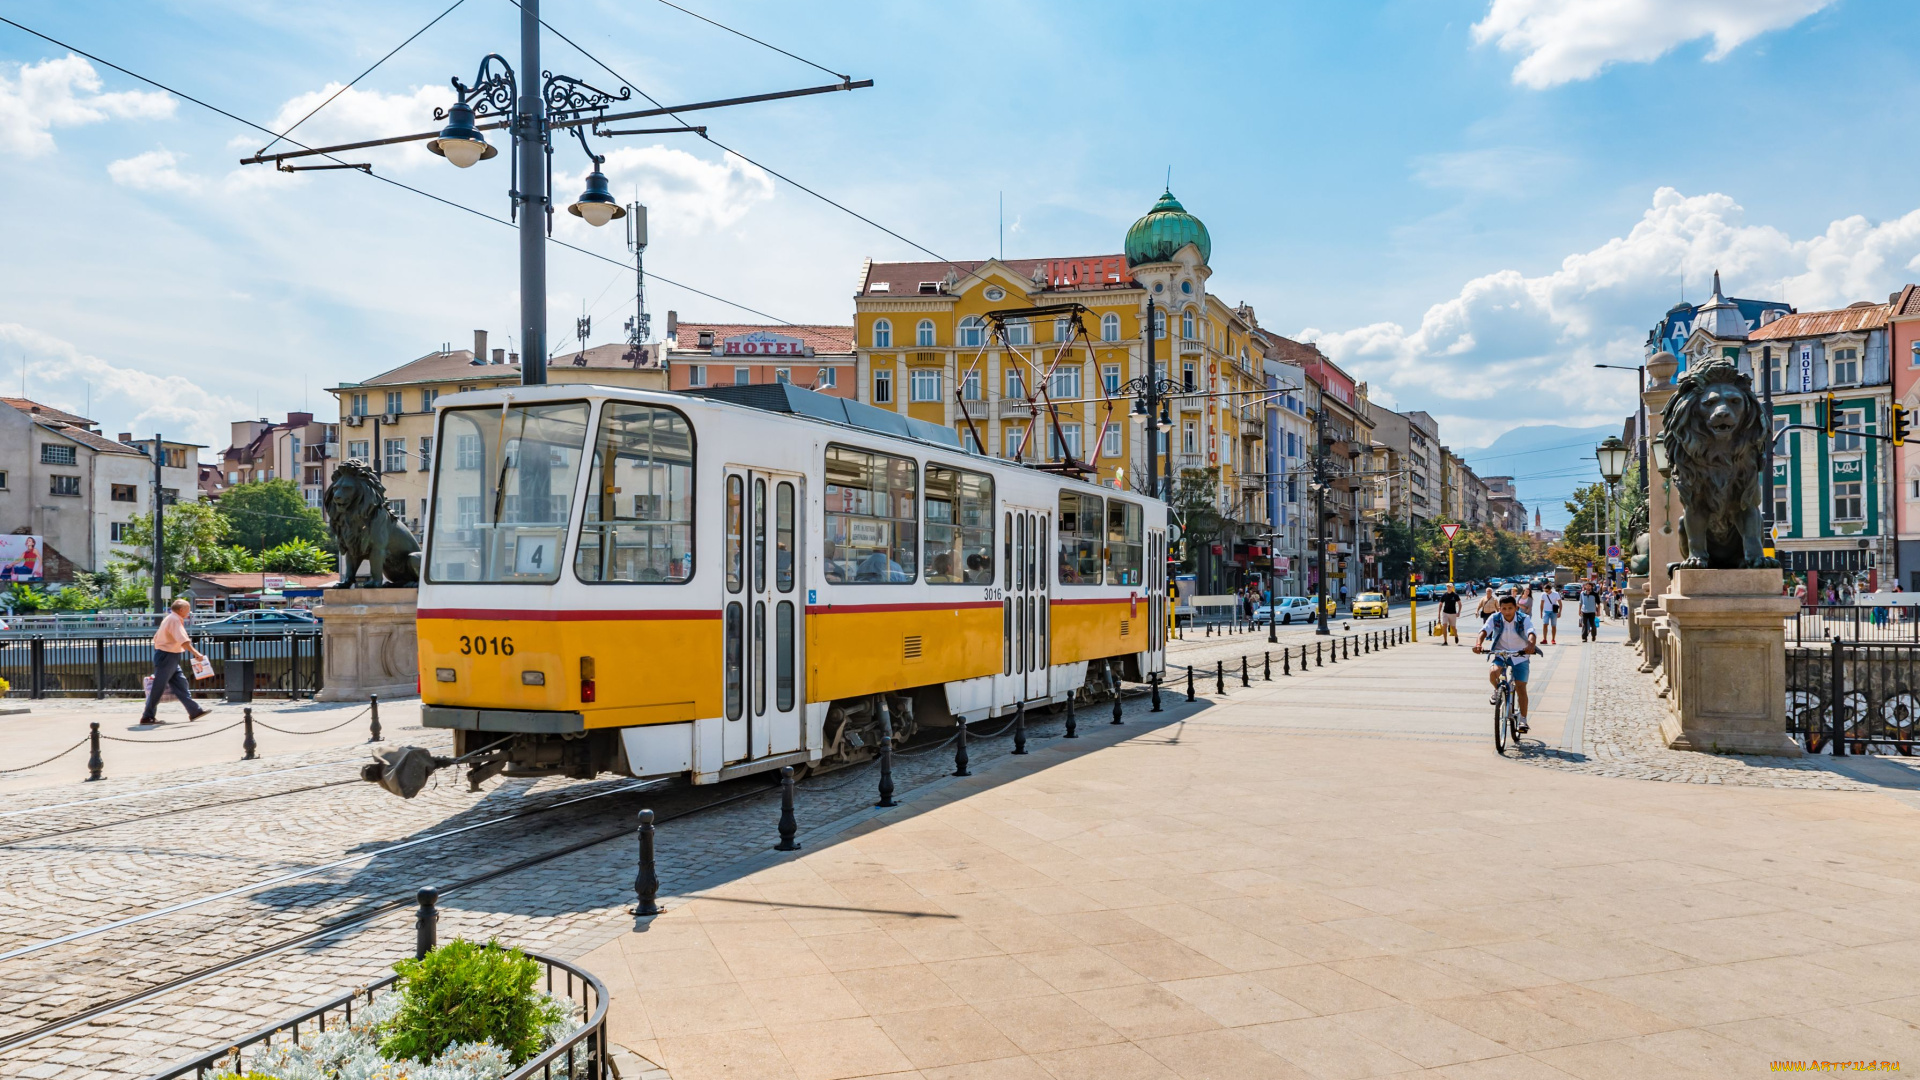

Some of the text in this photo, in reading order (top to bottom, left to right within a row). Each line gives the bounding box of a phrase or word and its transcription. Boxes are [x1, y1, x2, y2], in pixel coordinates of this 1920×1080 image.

[1047, 257, 1133, 286] HOTEL
[725, 342, 802, 354] HOTEL
[1801, 351, 1811, 392] HOTEL
[531, 544, 543, 569] 4
[984, 588, 1002, 601] 3016
[459, 635, 514, 656] 3016
